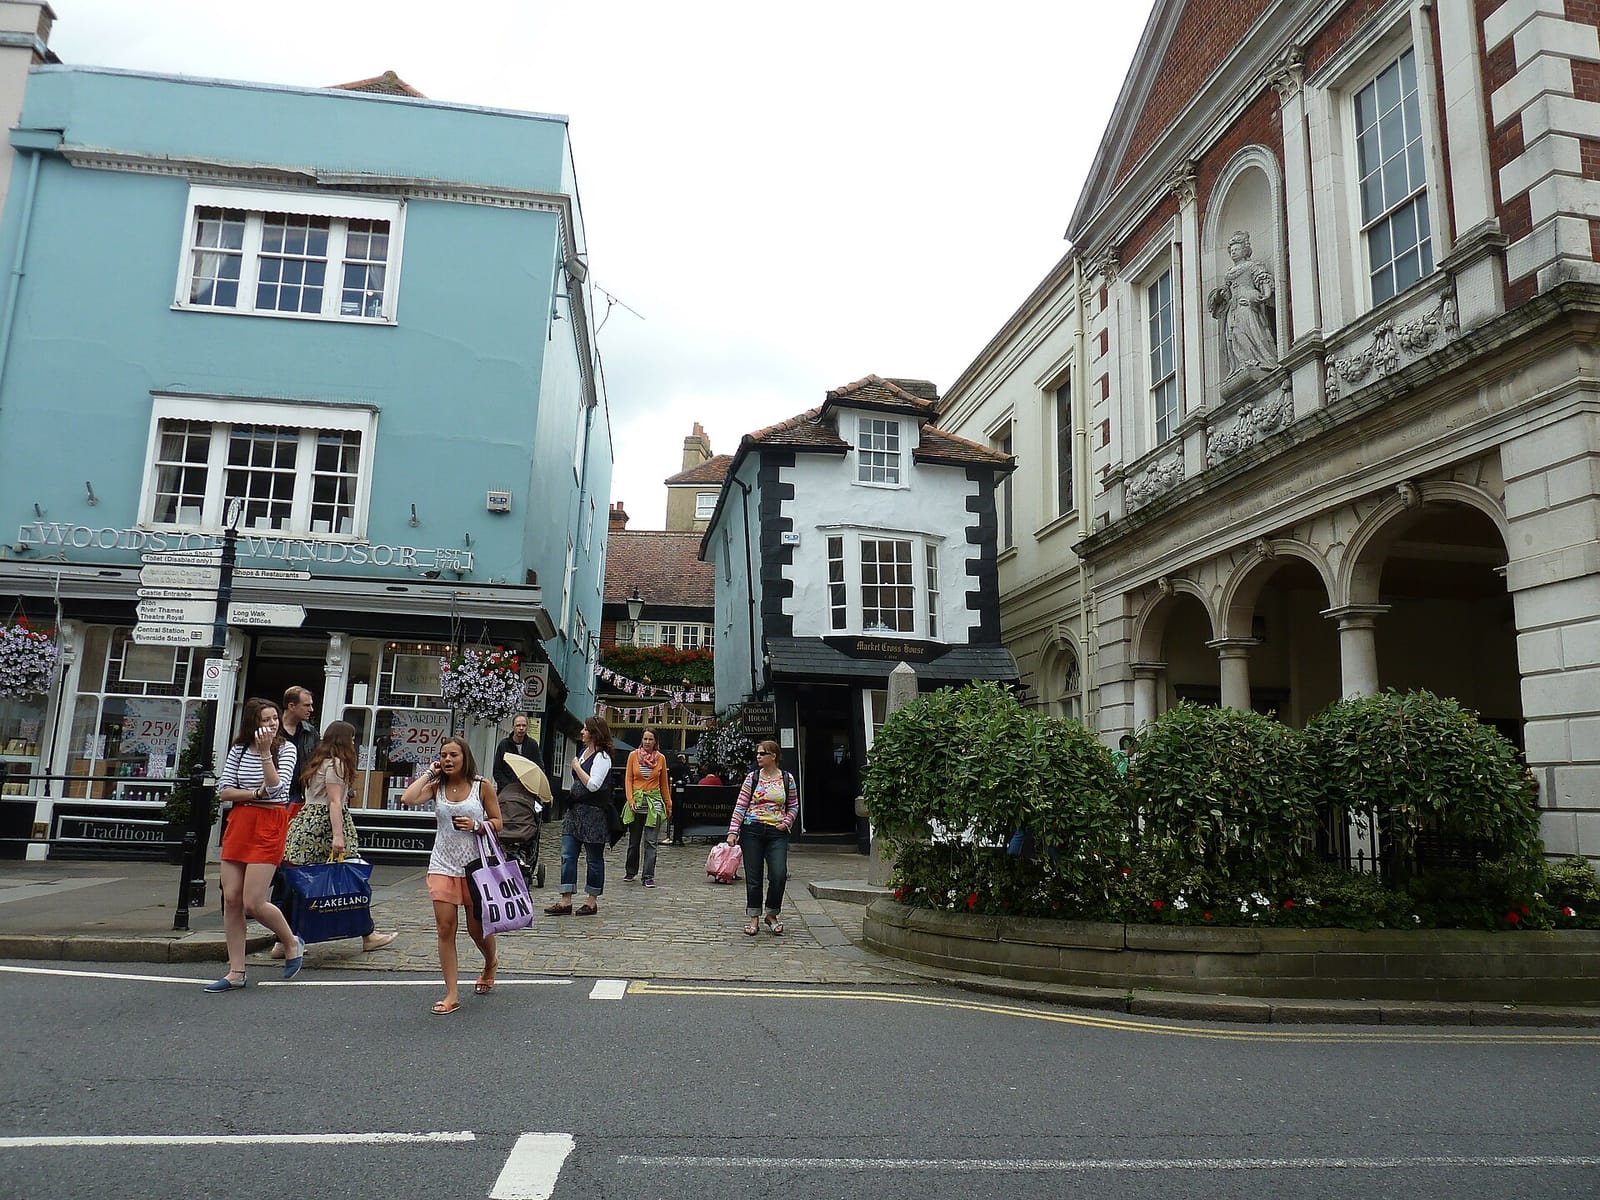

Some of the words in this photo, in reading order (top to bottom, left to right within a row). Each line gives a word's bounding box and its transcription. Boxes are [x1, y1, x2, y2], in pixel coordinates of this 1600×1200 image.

[33, 521, 168, 551] WOODS
[245, 536, 420, 567] WINDSOR
[435, 547, 460, 559] EST
[145, 554, 162, 562] Toilet
[434, 558, 460, 570] 1770
[233, 569, 254, 577] Shops
[261, 570, 299, 578] Restaurants
[163, 590, 192, 598] Entrance
[158, 606, 184, 614] Thames
[233, 609, 249, 617] Long
[161, 626, 185, 634] Station
[135, 633, 165, 641] Riverside
[166, 634, 190, 642] Station
[857, 640, 880, 652] Market
[881, 641, 902, 653] Cross
[903, 643, 925, 655] House
[408, 714, 449, 724] YARDLEY
[748, 714, 769, 722] HOUSE
[141, 720, 180, 738] 25%
[744, 725, 774, 733] WINDSOR
[406, 728, 447, 745] 25%
[150, 738, 170, 746] OFF
[416, 746, 436, 755] OFF
[79, 821, 165, 841] Traditiona
[358, 832, 425, 849] erfumers
[319, 895, 369, 909] LAKELAND
[489, 897, 531, 923] DON
